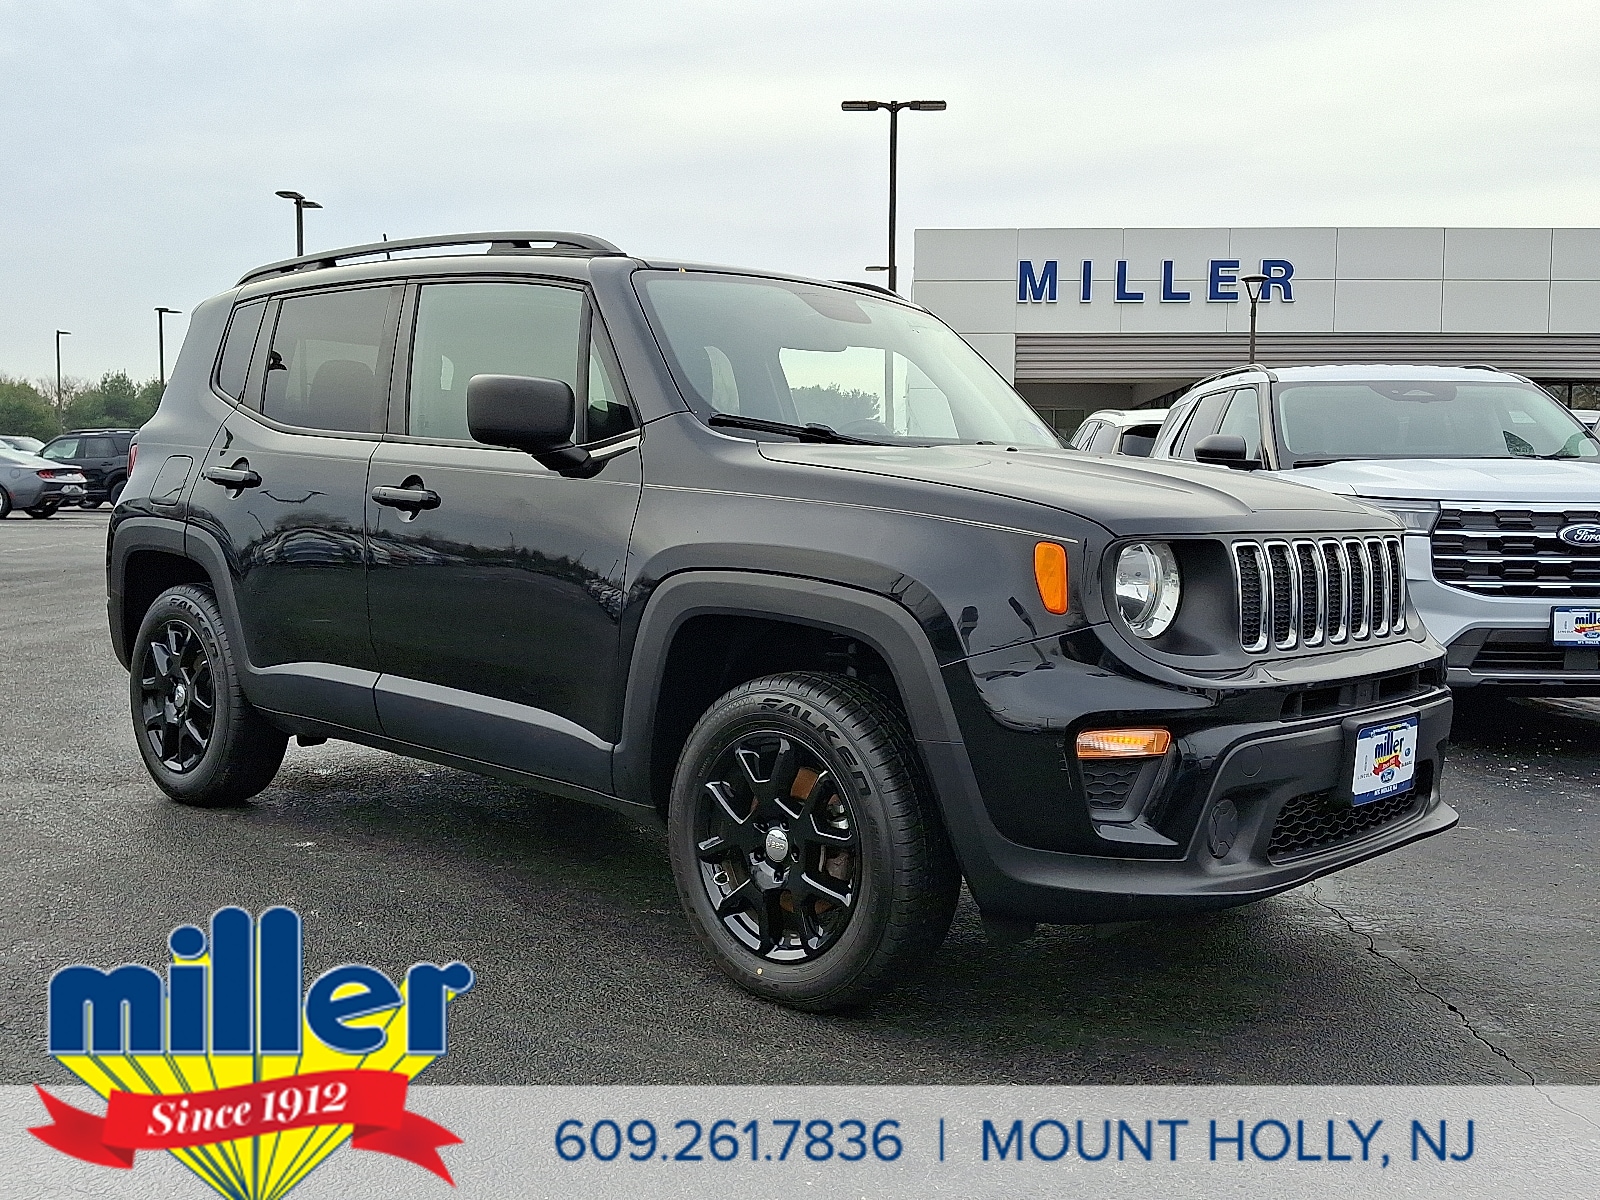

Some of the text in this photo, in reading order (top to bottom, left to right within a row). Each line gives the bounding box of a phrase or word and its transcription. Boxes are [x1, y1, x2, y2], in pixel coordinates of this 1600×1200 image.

[1017, 259, 1296, 302] MILLER
[757, 697, 872, 796] FALKEN
[1375, 731, 1404, 759] miller
